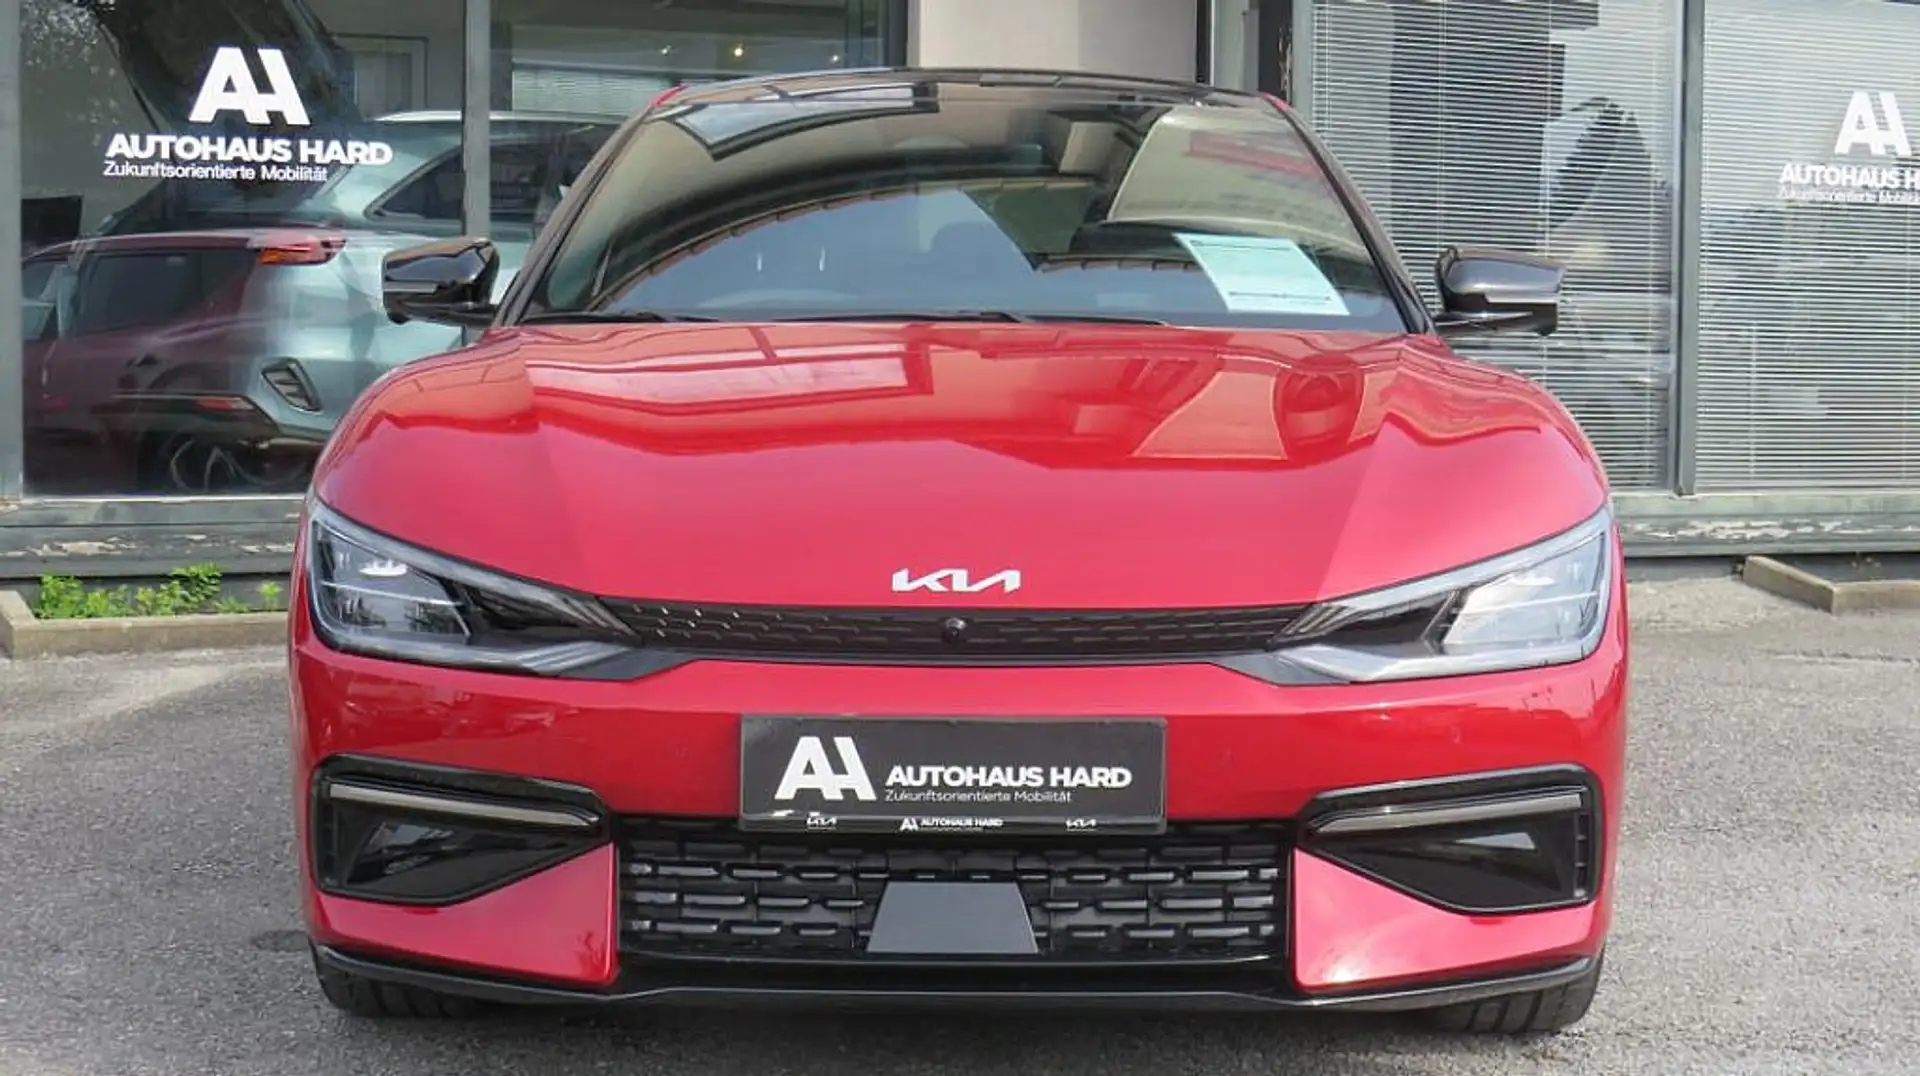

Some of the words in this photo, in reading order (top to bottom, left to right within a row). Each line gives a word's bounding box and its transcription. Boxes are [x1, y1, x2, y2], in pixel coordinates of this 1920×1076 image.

[104, 133, 292, 163] AUTOHAUS
[300, 138, 394, 166] HARD
[103, 160, 256, 180] Zukunftsorientierte
[261, 164, 328, 182] Mobilität
[1779, 162, 1902, 189] AUTOHAUS
[892, 568, 1021, 593] KIA
[884, 765, 1045, 788] AUTOHAUS
[1049, 766, 1133, 789] HARD
[884, 788, 1011, 803] Zukunftsorientierte
[1014, 790, 1072, 803] Mobilität
